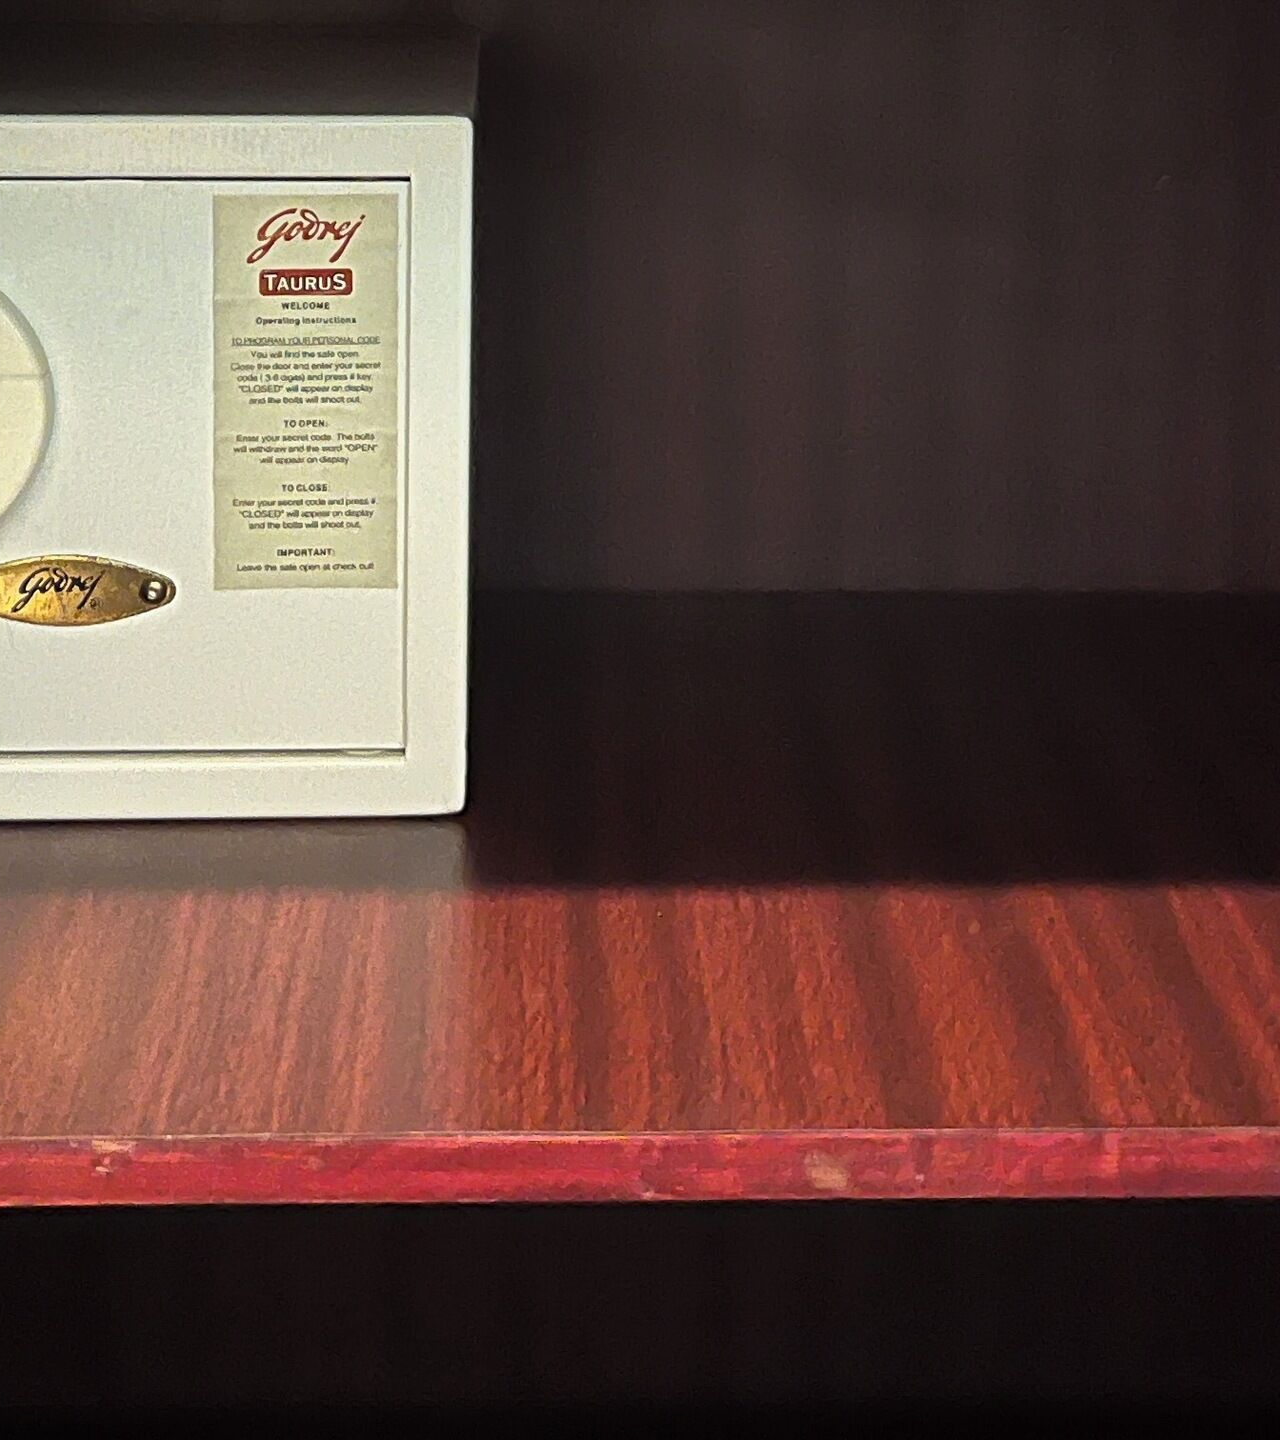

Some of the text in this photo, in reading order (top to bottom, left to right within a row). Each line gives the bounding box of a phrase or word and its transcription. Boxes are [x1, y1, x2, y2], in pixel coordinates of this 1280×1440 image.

[247, 208, 366, 264] Godrej
[281, 302, 330, 310] WELCOME
[256, 317, 300, 325] Operating
[357, 336, 381, 345] CODE
[335, 363, 353, 371] your
[284, 419, 297, 428] TO
[261, 435, 280, 443] your
[337, 433, 353, 441] The
[288, 445, 304, 453] and
[282, 484, 294, 492] TO
[257, 500, 276, 508] your
[11, 567, 106, 612] Godrej
